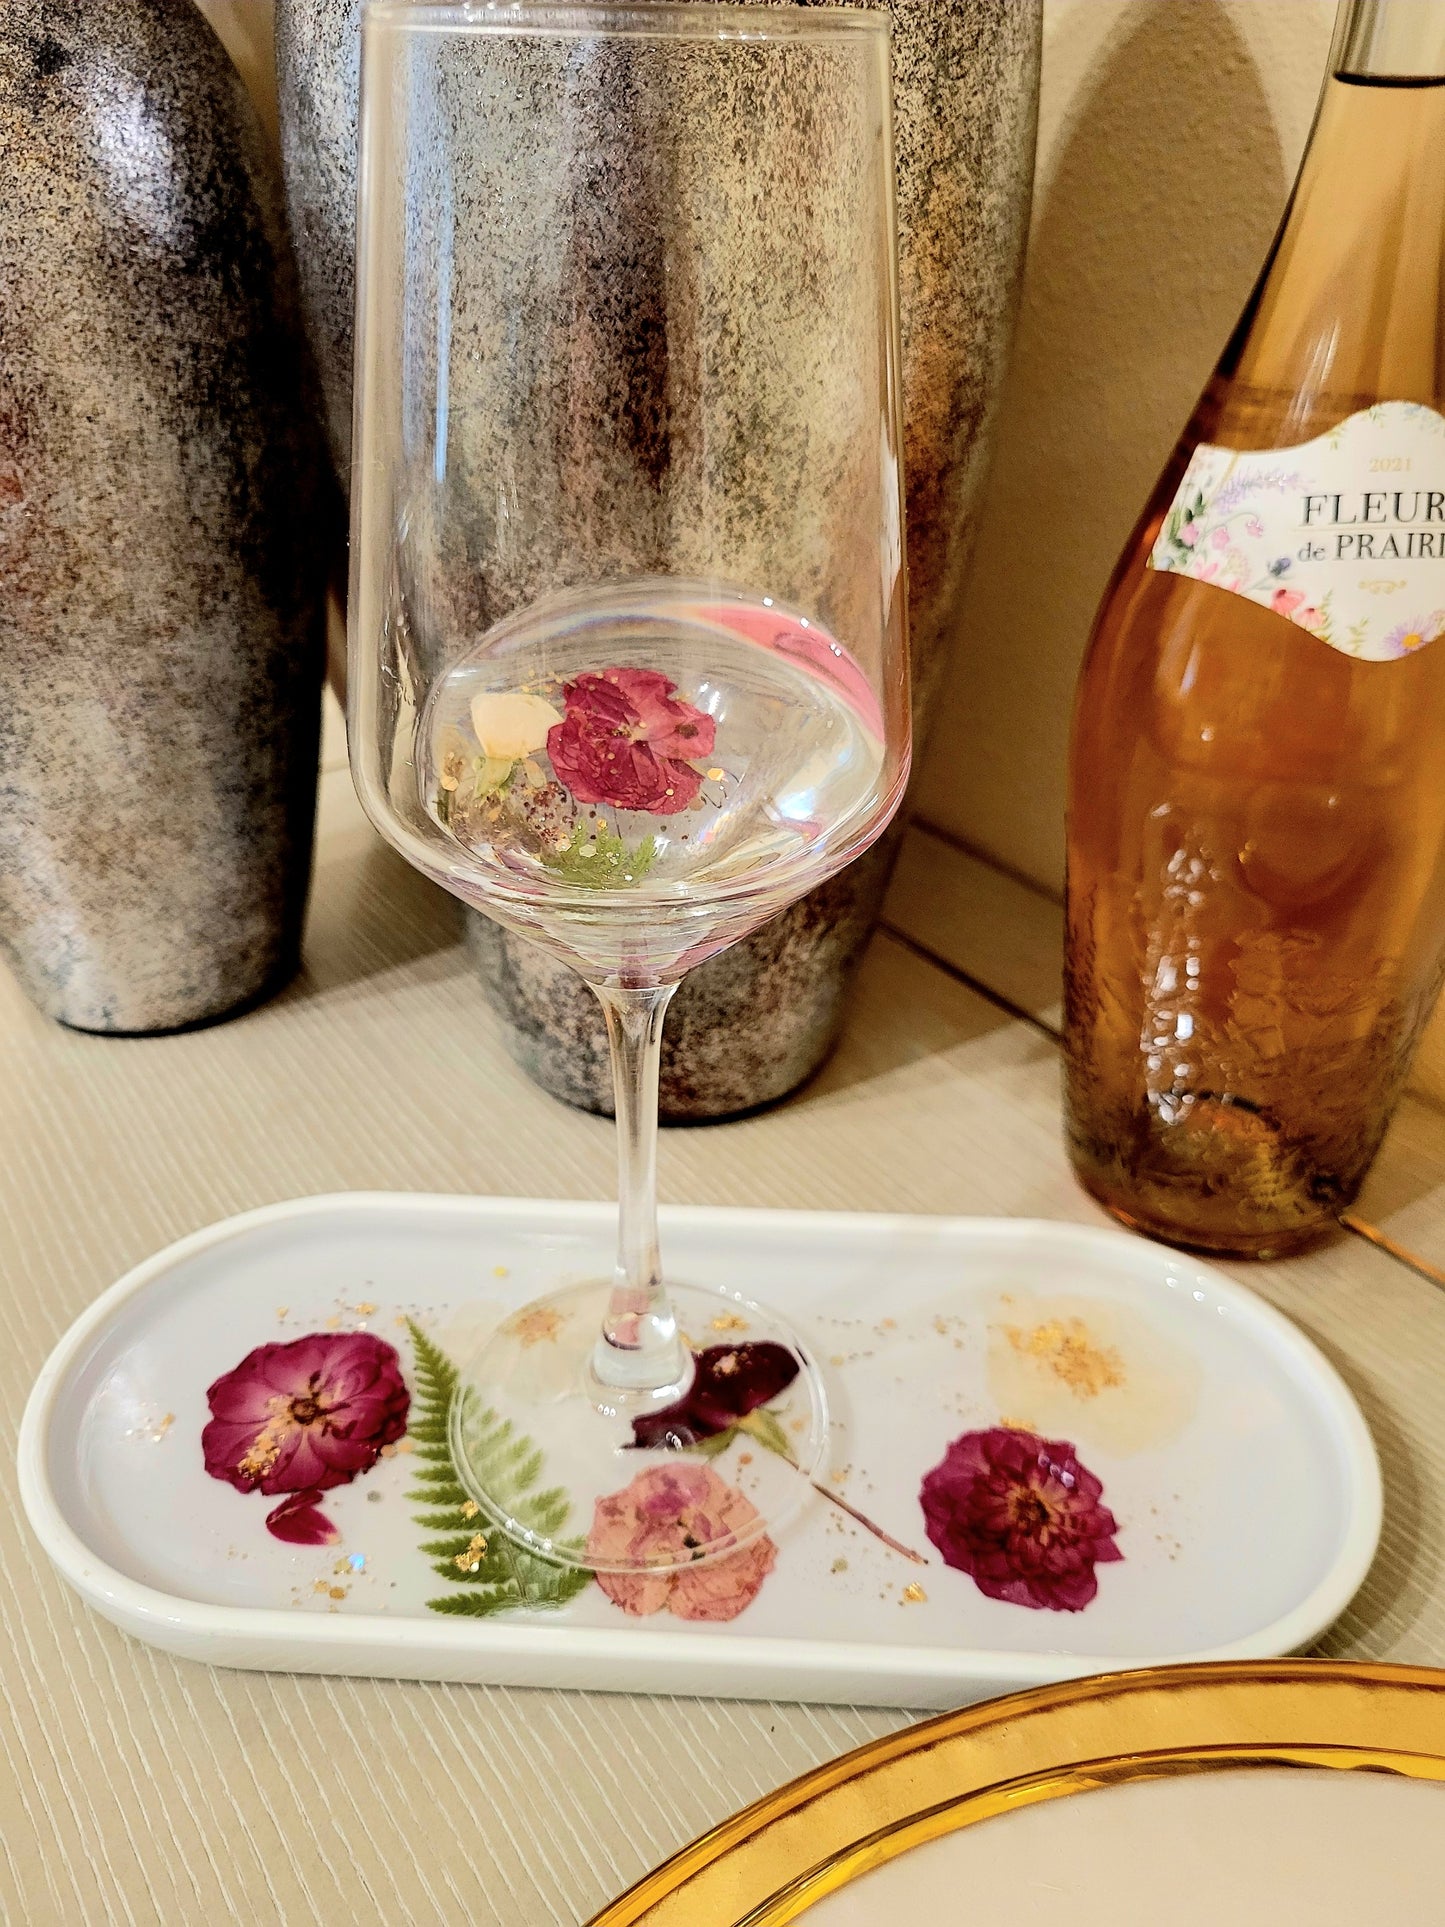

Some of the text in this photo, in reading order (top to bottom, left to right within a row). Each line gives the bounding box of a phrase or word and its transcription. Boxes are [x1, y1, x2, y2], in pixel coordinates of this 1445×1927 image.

[1370, 457, 1411, 472] 2021
[1299, 491, 1445, 526] FLEUR
[1297, 541, 1325, 561] de
